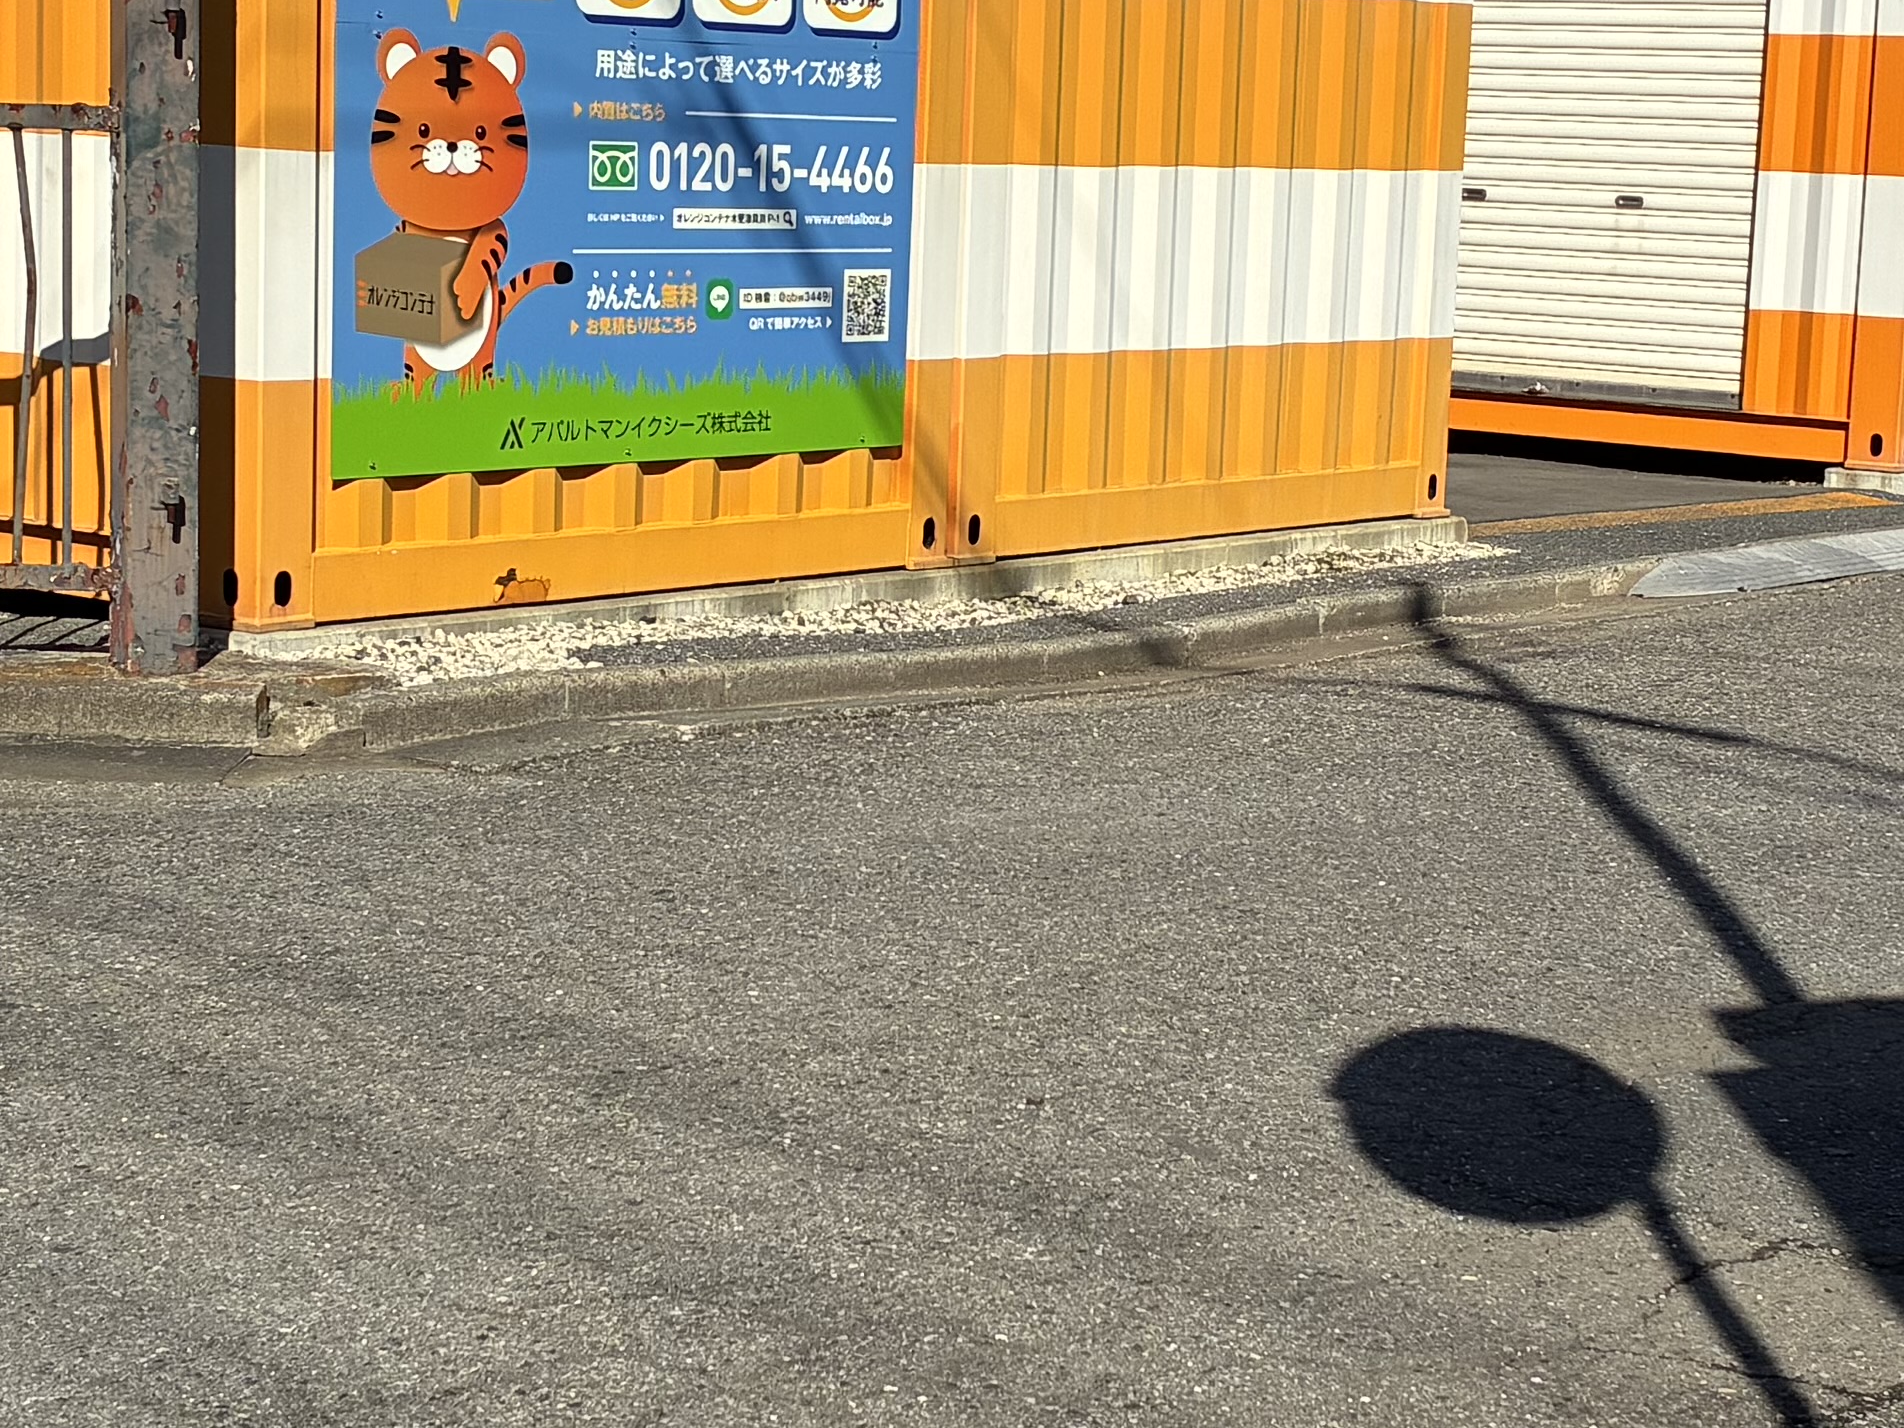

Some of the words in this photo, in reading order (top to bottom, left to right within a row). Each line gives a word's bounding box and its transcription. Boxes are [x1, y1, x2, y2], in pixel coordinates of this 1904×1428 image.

[595, 49, 882, 90] 用途によって選べるサイズが多彩
[648, 140, 894, 195] 0120-15-4466
[804, 212, 893, 226] www.rentalbox.jp
[530, 409, 772, 444] アパルトマンイクシーズ株式会社
